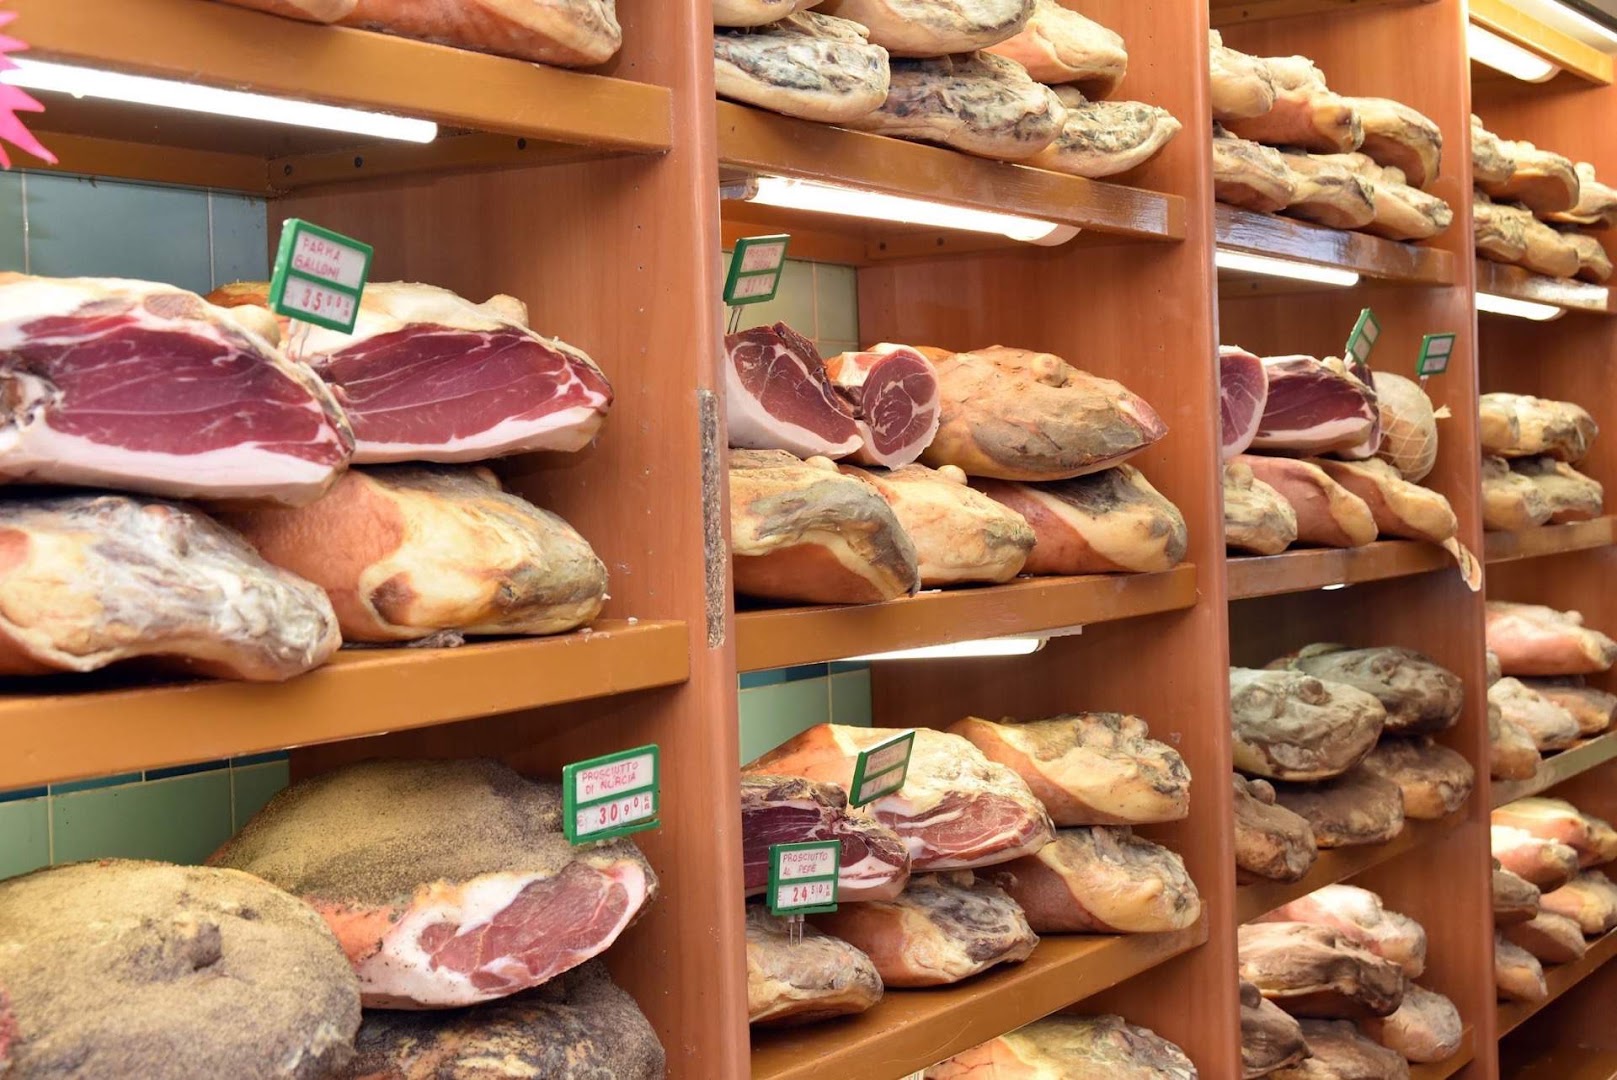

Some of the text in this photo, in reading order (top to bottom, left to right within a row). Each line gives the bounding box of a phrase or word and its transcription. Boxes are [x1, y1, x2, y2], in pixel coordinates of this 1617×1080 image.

[303, 236, 341, 260] PARMA
[582, 761, 639, 782] PROSCIUTTO
[585, 785, 594, 795] DI
[782, 850, 829, 862] PROSCIUTTO
[799, 863, 817, 874] PEPE
